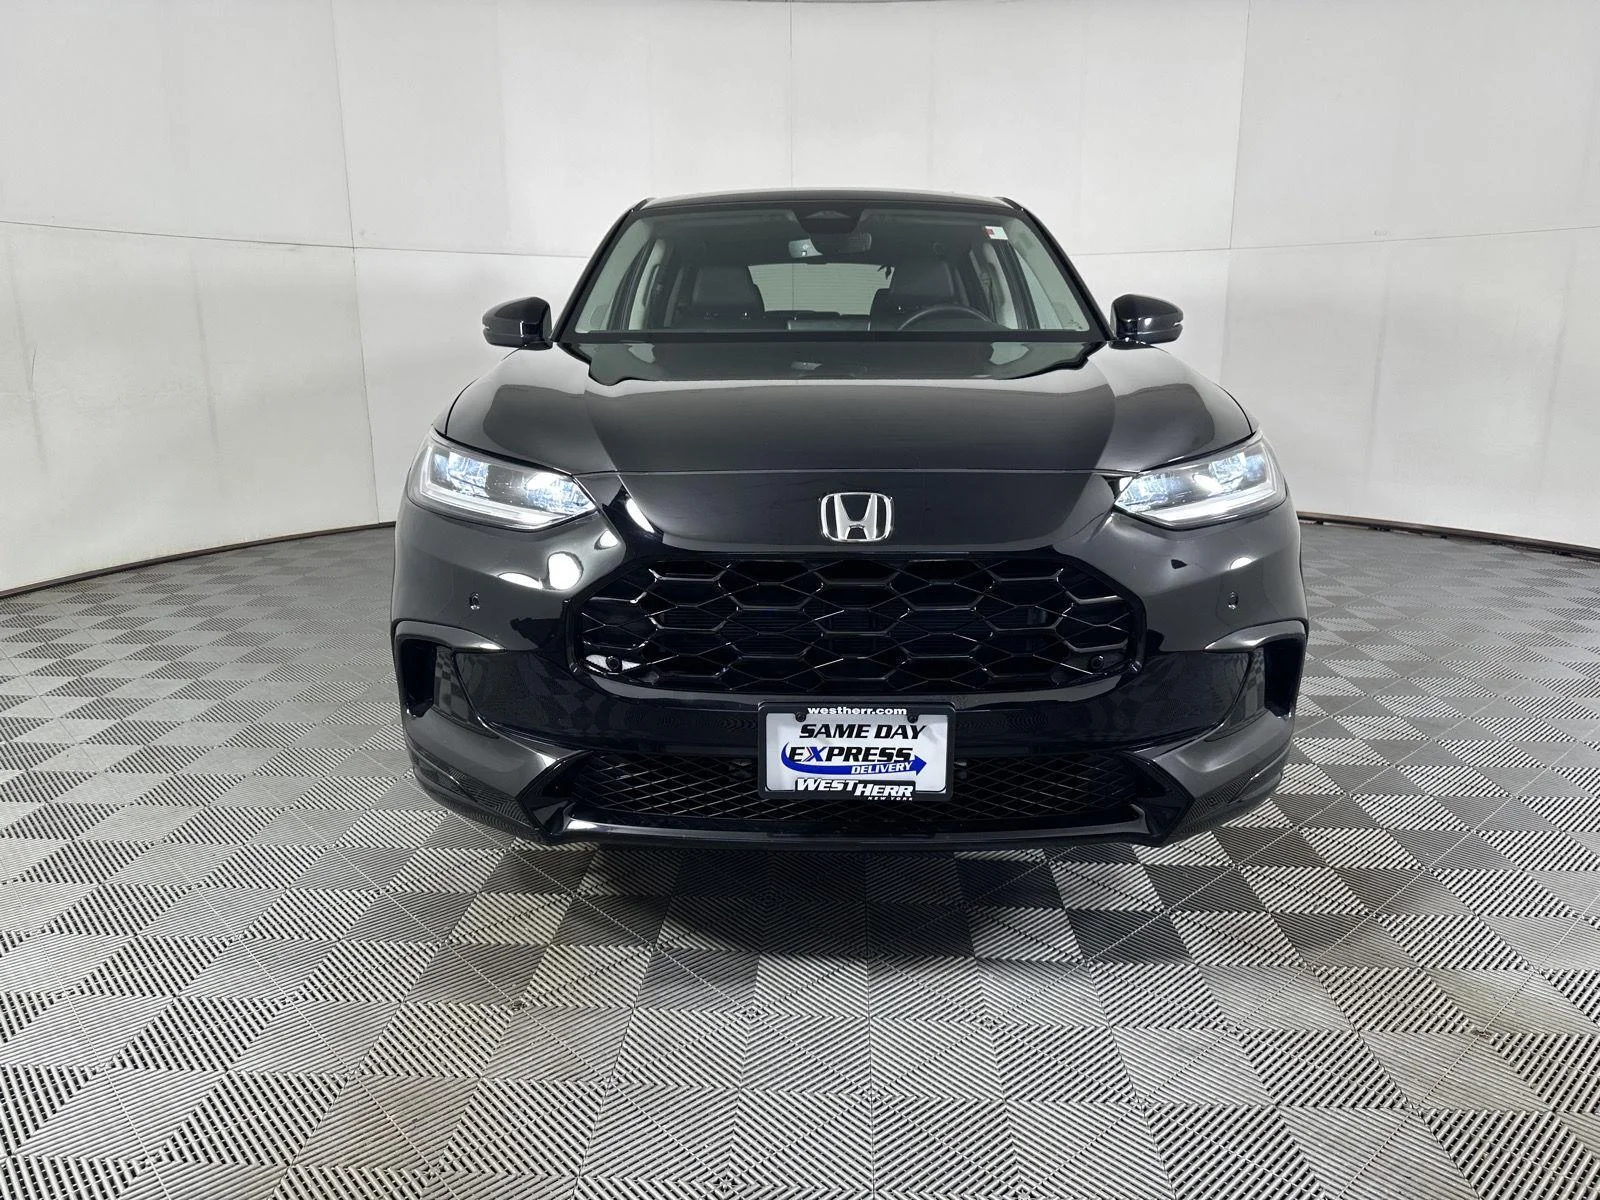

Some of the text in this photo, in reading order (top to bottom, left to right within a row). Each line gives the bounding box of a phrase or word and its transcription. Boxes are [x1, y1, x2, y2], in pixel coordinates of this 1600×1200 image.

[807, 706, 907, 715] westherr.com
[800, 723, 927, 740] SAME DAY
[788, 746, 913, 763] EXPRESS
[851, 761, 913, 775] DELIVERY
